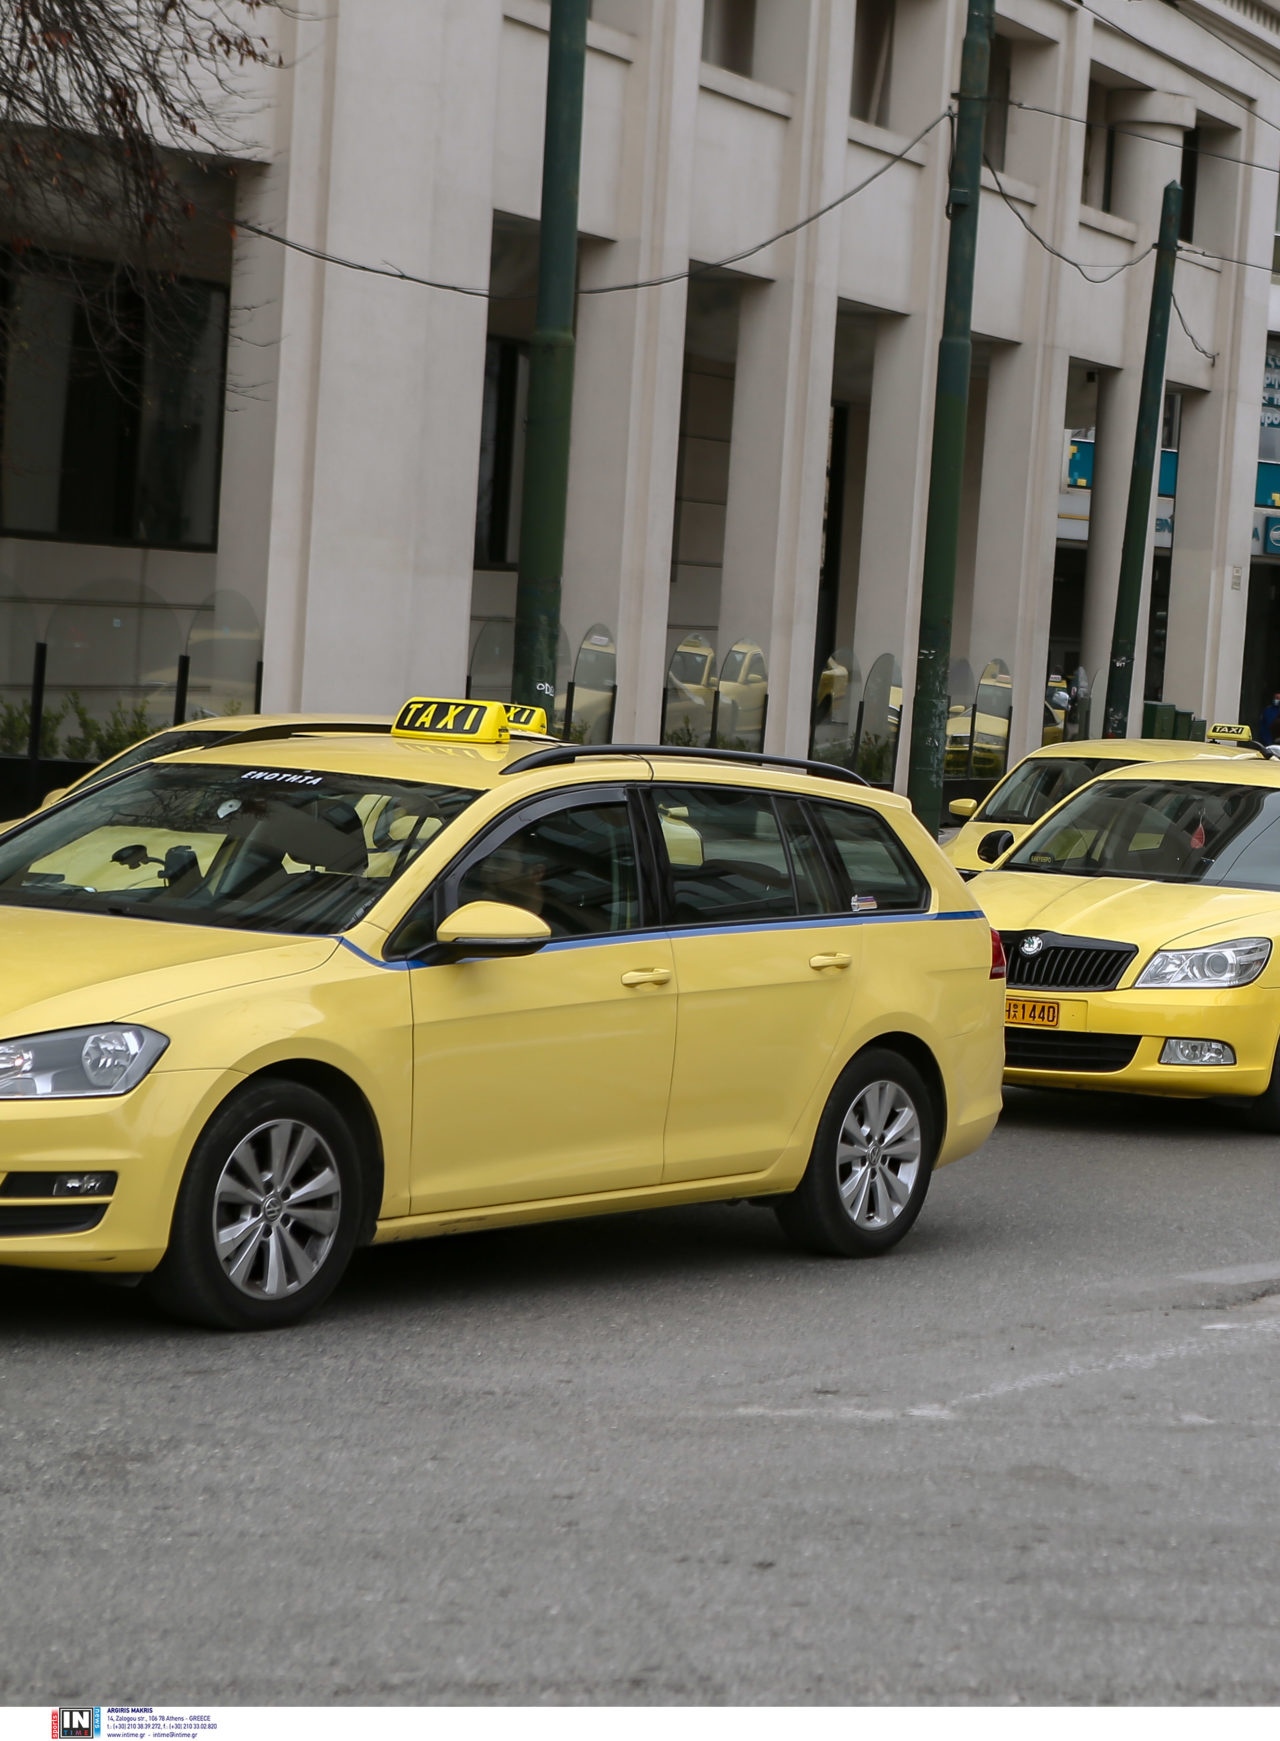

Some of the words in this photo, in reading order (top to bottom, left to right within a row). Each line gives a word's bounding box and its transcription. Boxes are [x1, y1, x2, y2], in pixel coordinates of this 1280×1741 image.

[402, 703, 480, 731] TAXI
[506, 706, 531, 723] XI
[1215, 726, 1244, 735] TAXI
